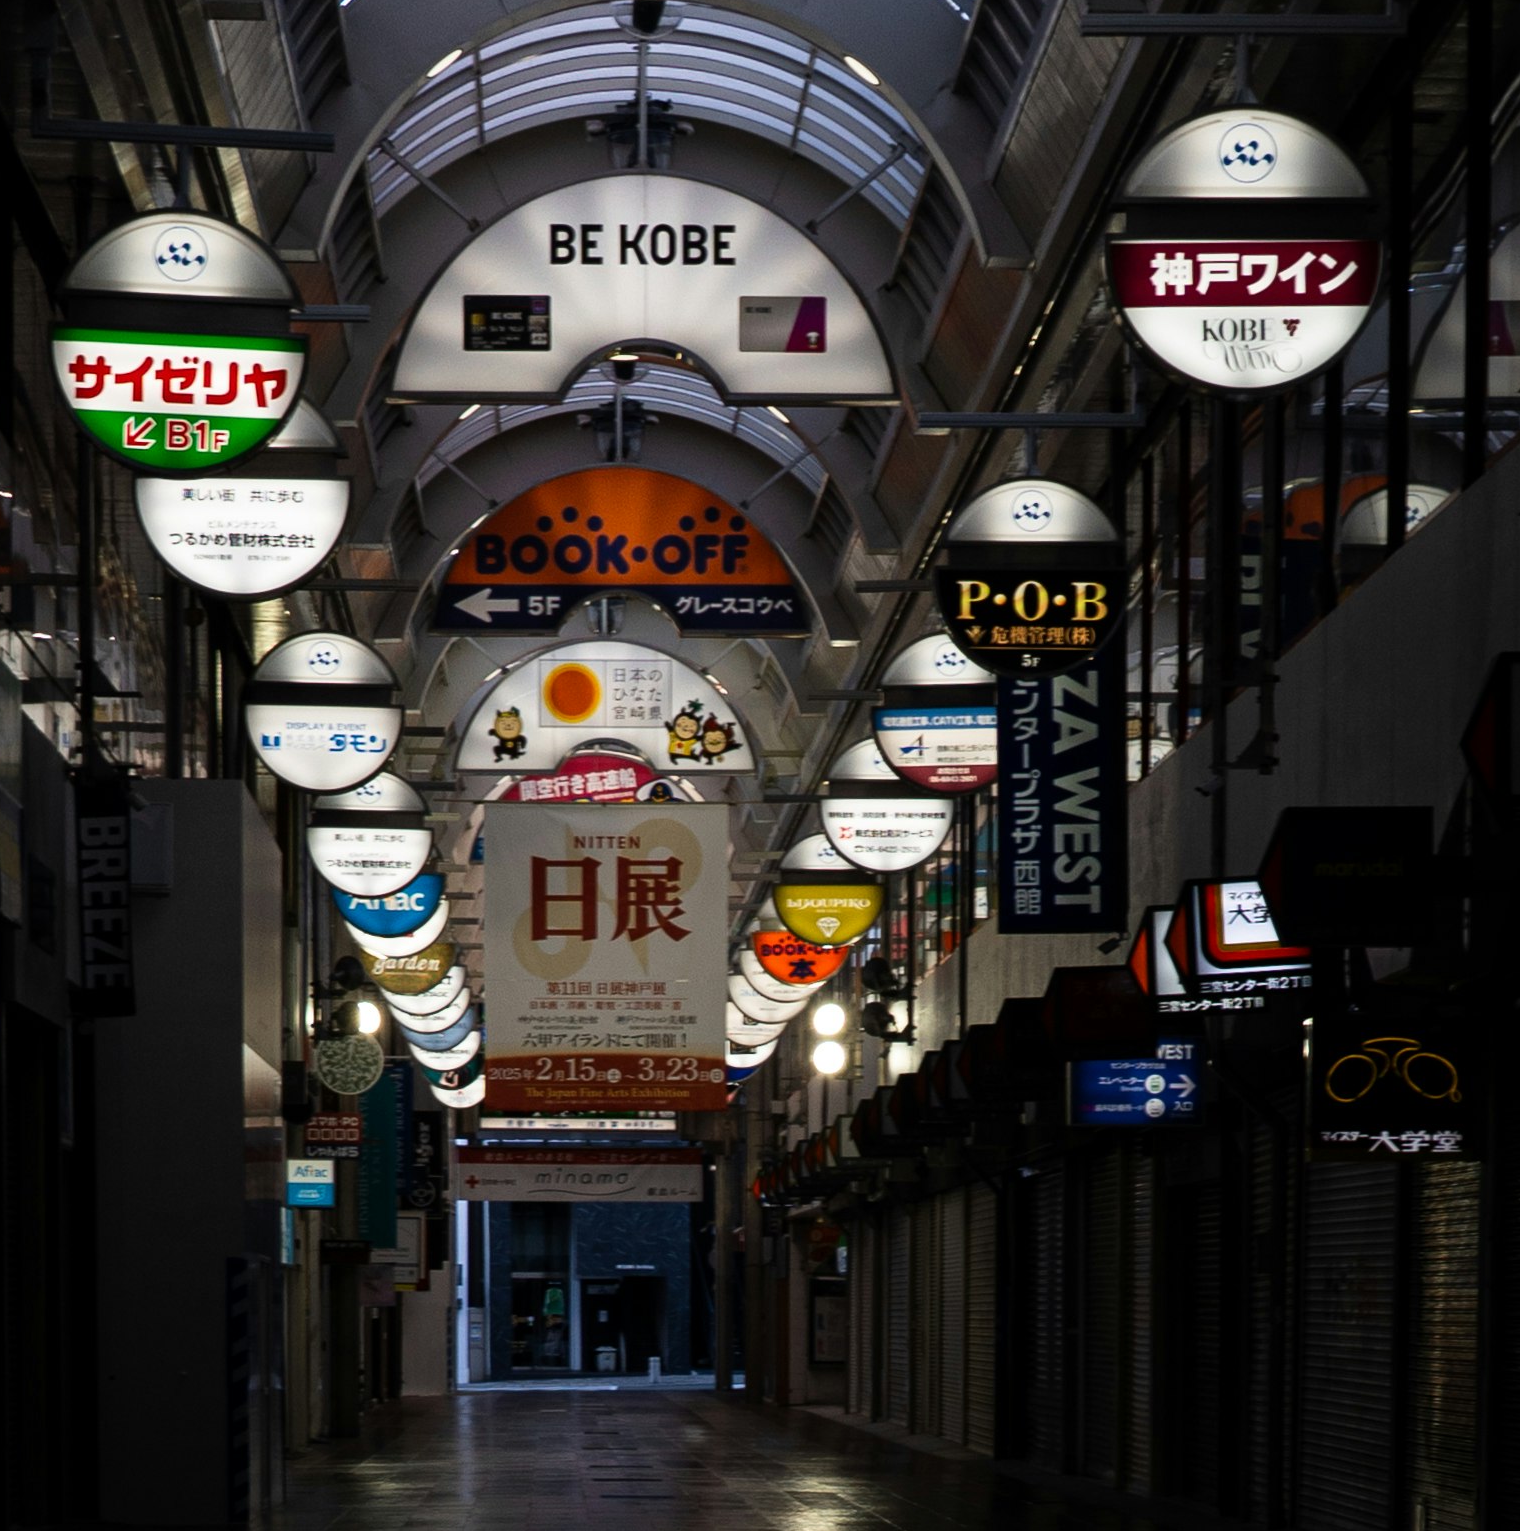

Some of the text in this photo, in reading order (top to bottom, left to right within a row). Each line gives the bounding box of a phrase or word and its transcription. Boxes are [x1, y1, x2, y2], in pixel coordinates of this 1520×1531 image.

[549, 223, 737, 266] BE KOBE
[1149, 251, 1359, 296] 神戸ワイン
[1201, 317, 1278, 342] KOBE
[68, 353, 288, 408] サイゼリヤ
[164, 419, 231, 453] B1F
[527, 596, 561, 616] 5F
[674, 596, 794, 615] グレースコウベ
[612, 668, 663, 683] 日本の
[613, 686, 663, 701] ひなた
[612, 704, 663, 721] 宮崎県
[1010, 673, 1042, 915] ンタープラザ西館
[573, 836, 642, 850] NITTEN
[1051, 767, 1101, 915] WEST
[78, 815, 132, 990] BREEZE
[530, 855, 692, 942] 日展
[547, 981, 592, 996] 第11回
[525, 1087, 690, 1100] The Japan Fine Arts Exhibition
